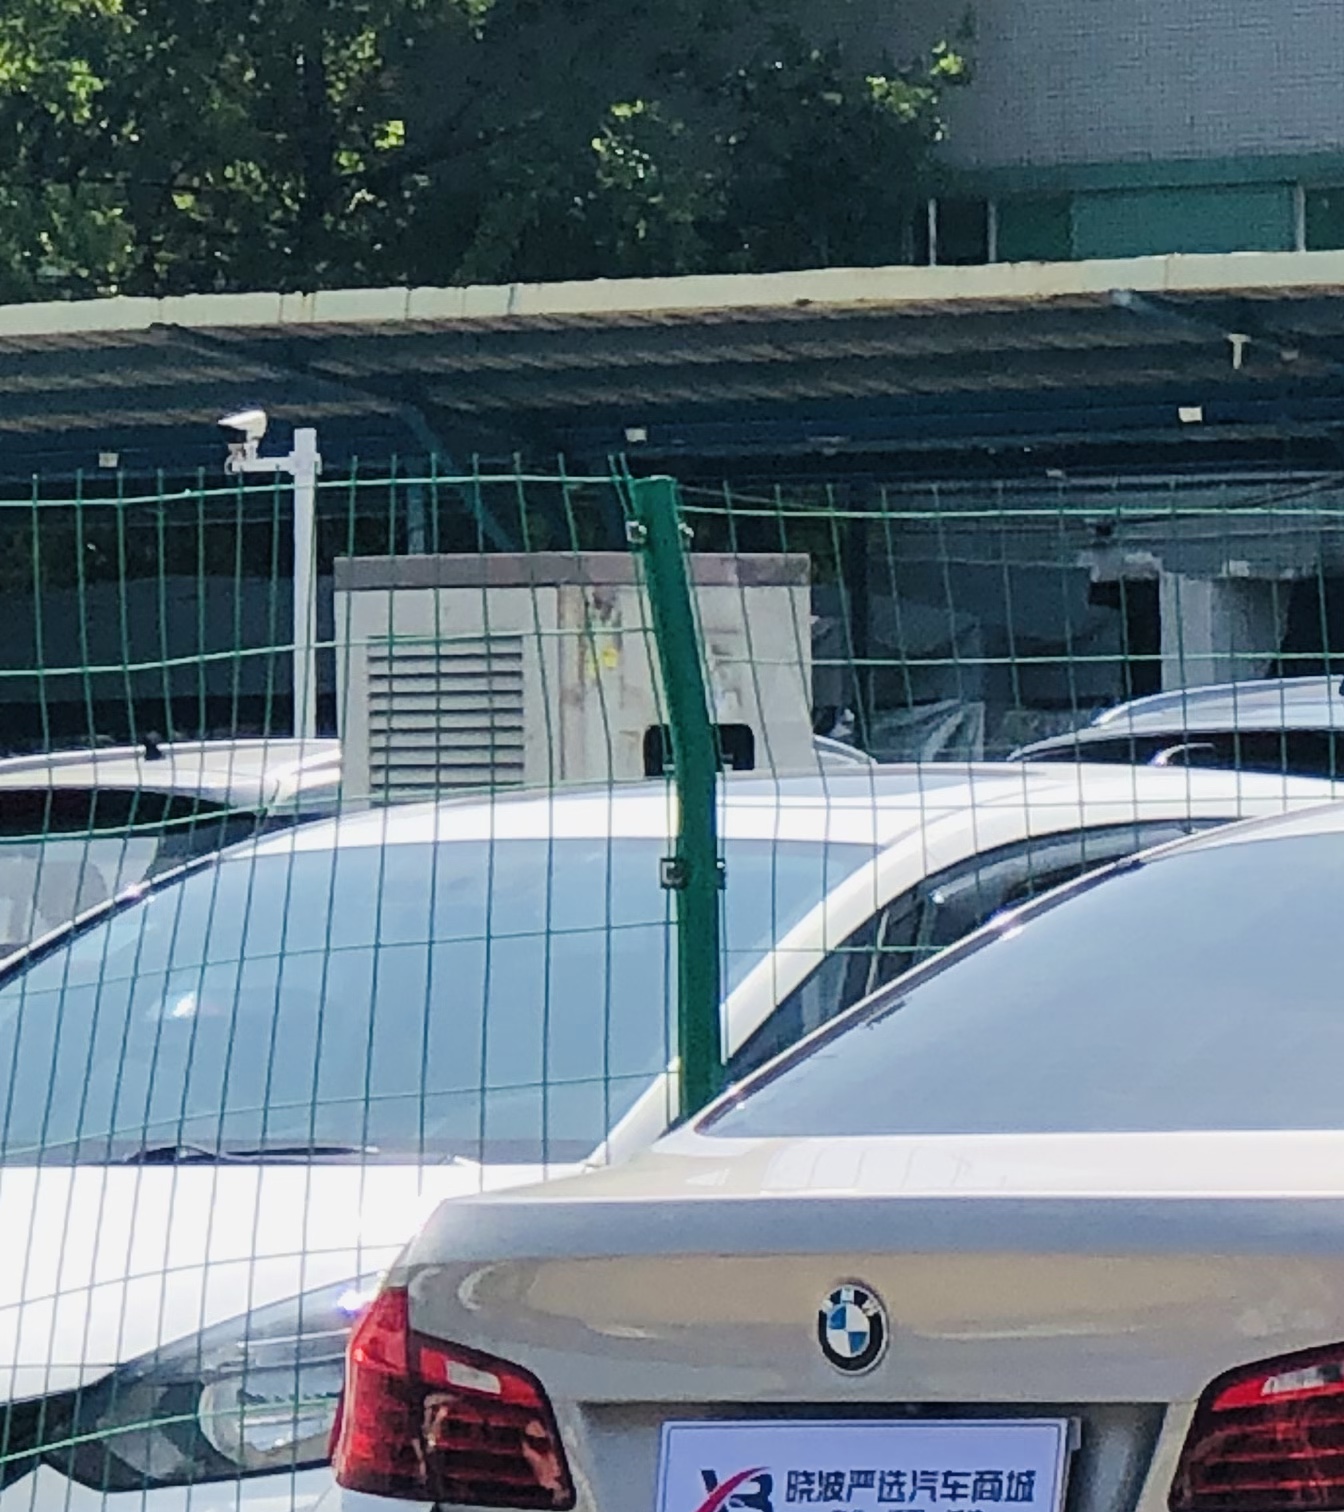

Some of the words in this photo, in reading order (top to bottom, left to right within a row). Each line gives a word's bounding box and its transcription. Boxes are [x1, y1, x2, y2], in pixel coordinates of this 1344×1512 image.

[786, 1469, 1036, 1503] 晓波严选汽车商城
